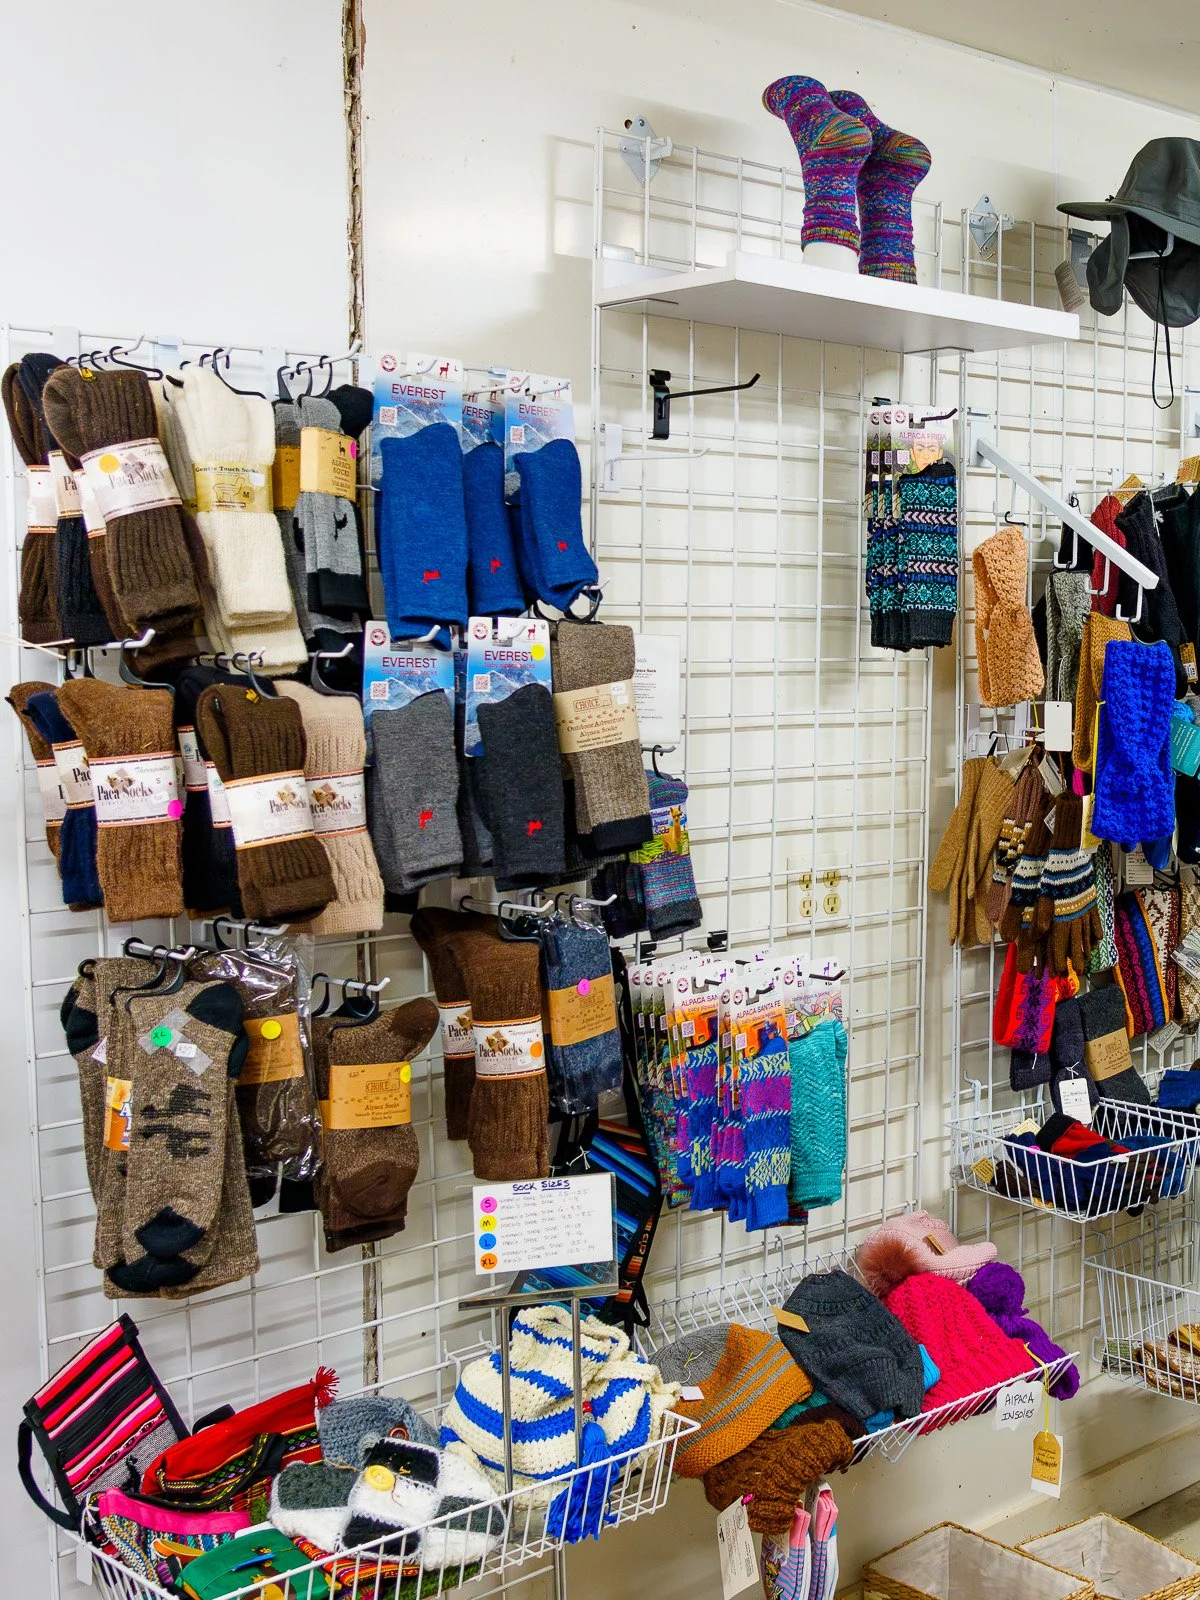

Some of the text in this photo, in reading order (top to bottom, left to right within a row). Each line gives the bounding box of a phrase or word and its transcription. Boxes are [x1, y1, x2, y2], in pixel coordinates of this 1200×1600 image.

[391, 383, 447, 400] EVEREST
[462, 405, 495, 421] VEREST
[519, 403, 561, 418] EVEREST
[899, 431, 926, 440] ALPACA
[63, 475, 78, 493] Pa
[382, 656, 438, 669] EVEREST
[484, 650, 534, 662] EVEREST
[575, 698, 600, 710] CHOICE
[72, 768, 91, 783] Pac
[97, 781, 153, 800] Paca Socks
[269, 800, 288, 814] Paca
[682, 993, 719, 1007] ALPACA SAN
[736, 1008, 757, 1019] ALPACA
[758, 1004, 774, 1013] SANTA
[153, 1032, 166, 1040] XL
[448, 1024, 468, 1038] Paca
[479, 1042, 523, 1058] Paca Socks
[513, 1179, 570, 1192] SOCK SIZES
[484, 1199, 492, 1208] S
[484, 1238, 490, 1247] L
[482, 1258, 495, 1267] XL
